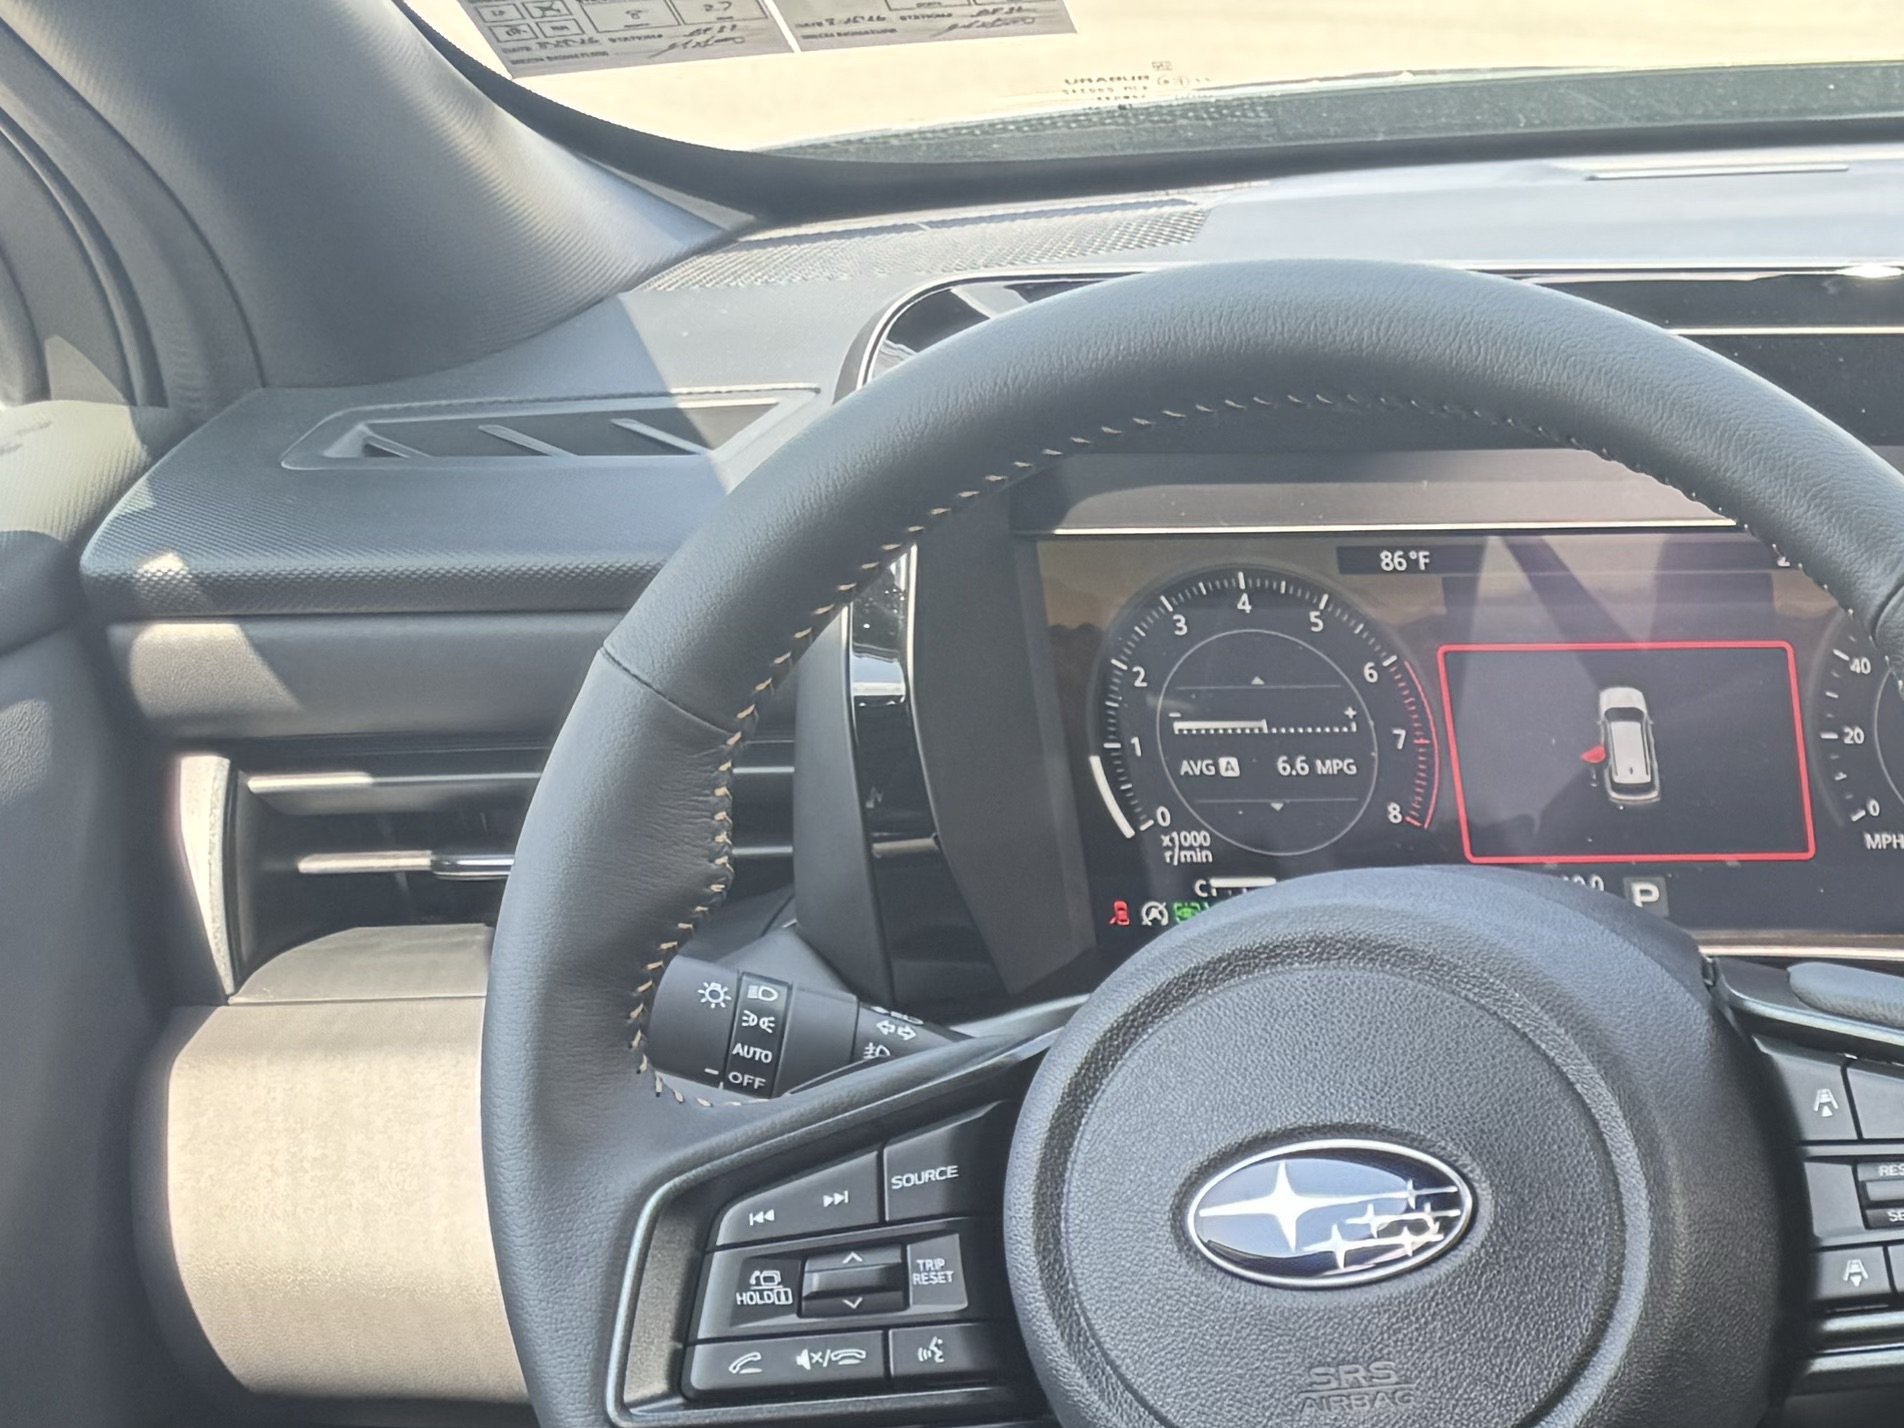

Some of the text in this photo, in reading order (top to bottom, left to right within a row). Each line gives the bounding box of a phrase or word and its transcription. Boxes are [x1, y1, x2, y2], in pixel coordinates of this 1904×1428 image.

[1380, 550, 1430, 571] 86°F
[1236, 593, 1252, 613] 4
[1173, 614, 1188, 635] 3
[1309, 611, 1324, 632] 5
[1363, 662, 1378, 683] 6
[1849, 657, 1871, 675] 40
[1132, 667, 1148, 687] 2
[1392, 729, 1406, 750] 7
[1843, 727, 1864, 744] 20
[1130, 737, 1143, 757] 1
[1180, 758, 1215, 776] AVG
[1277, 756, 1357, 776] 6.6 MPG
[1156, 806, 1171, 827] 0
[1388, 803, 1402, 823] 8
[1867, 800, 1880, 816] 0
[1160, 830, 1211, 849] x1000
[1863, 833, 1904, 850] MPH
[1164, 848, 1213, 866] r/min
[1194, 879, 1208, 897] C
[1631, 881, 1660, 908] P
[732, 1042, 773, 1065] AUTO
[728, 1072, 766, 1090] OFF
[891, 1164, 959, 1190] SOURCE
[916, 1258, 946, 1271] TRIP
[913, 1270, 955, 1285] RESET
[736, 1290, 772, 1306] HOLD
[1309, 1361, 1399, 1390] SRS
[1300, 1391, 1416, 1413] AIRBAG
